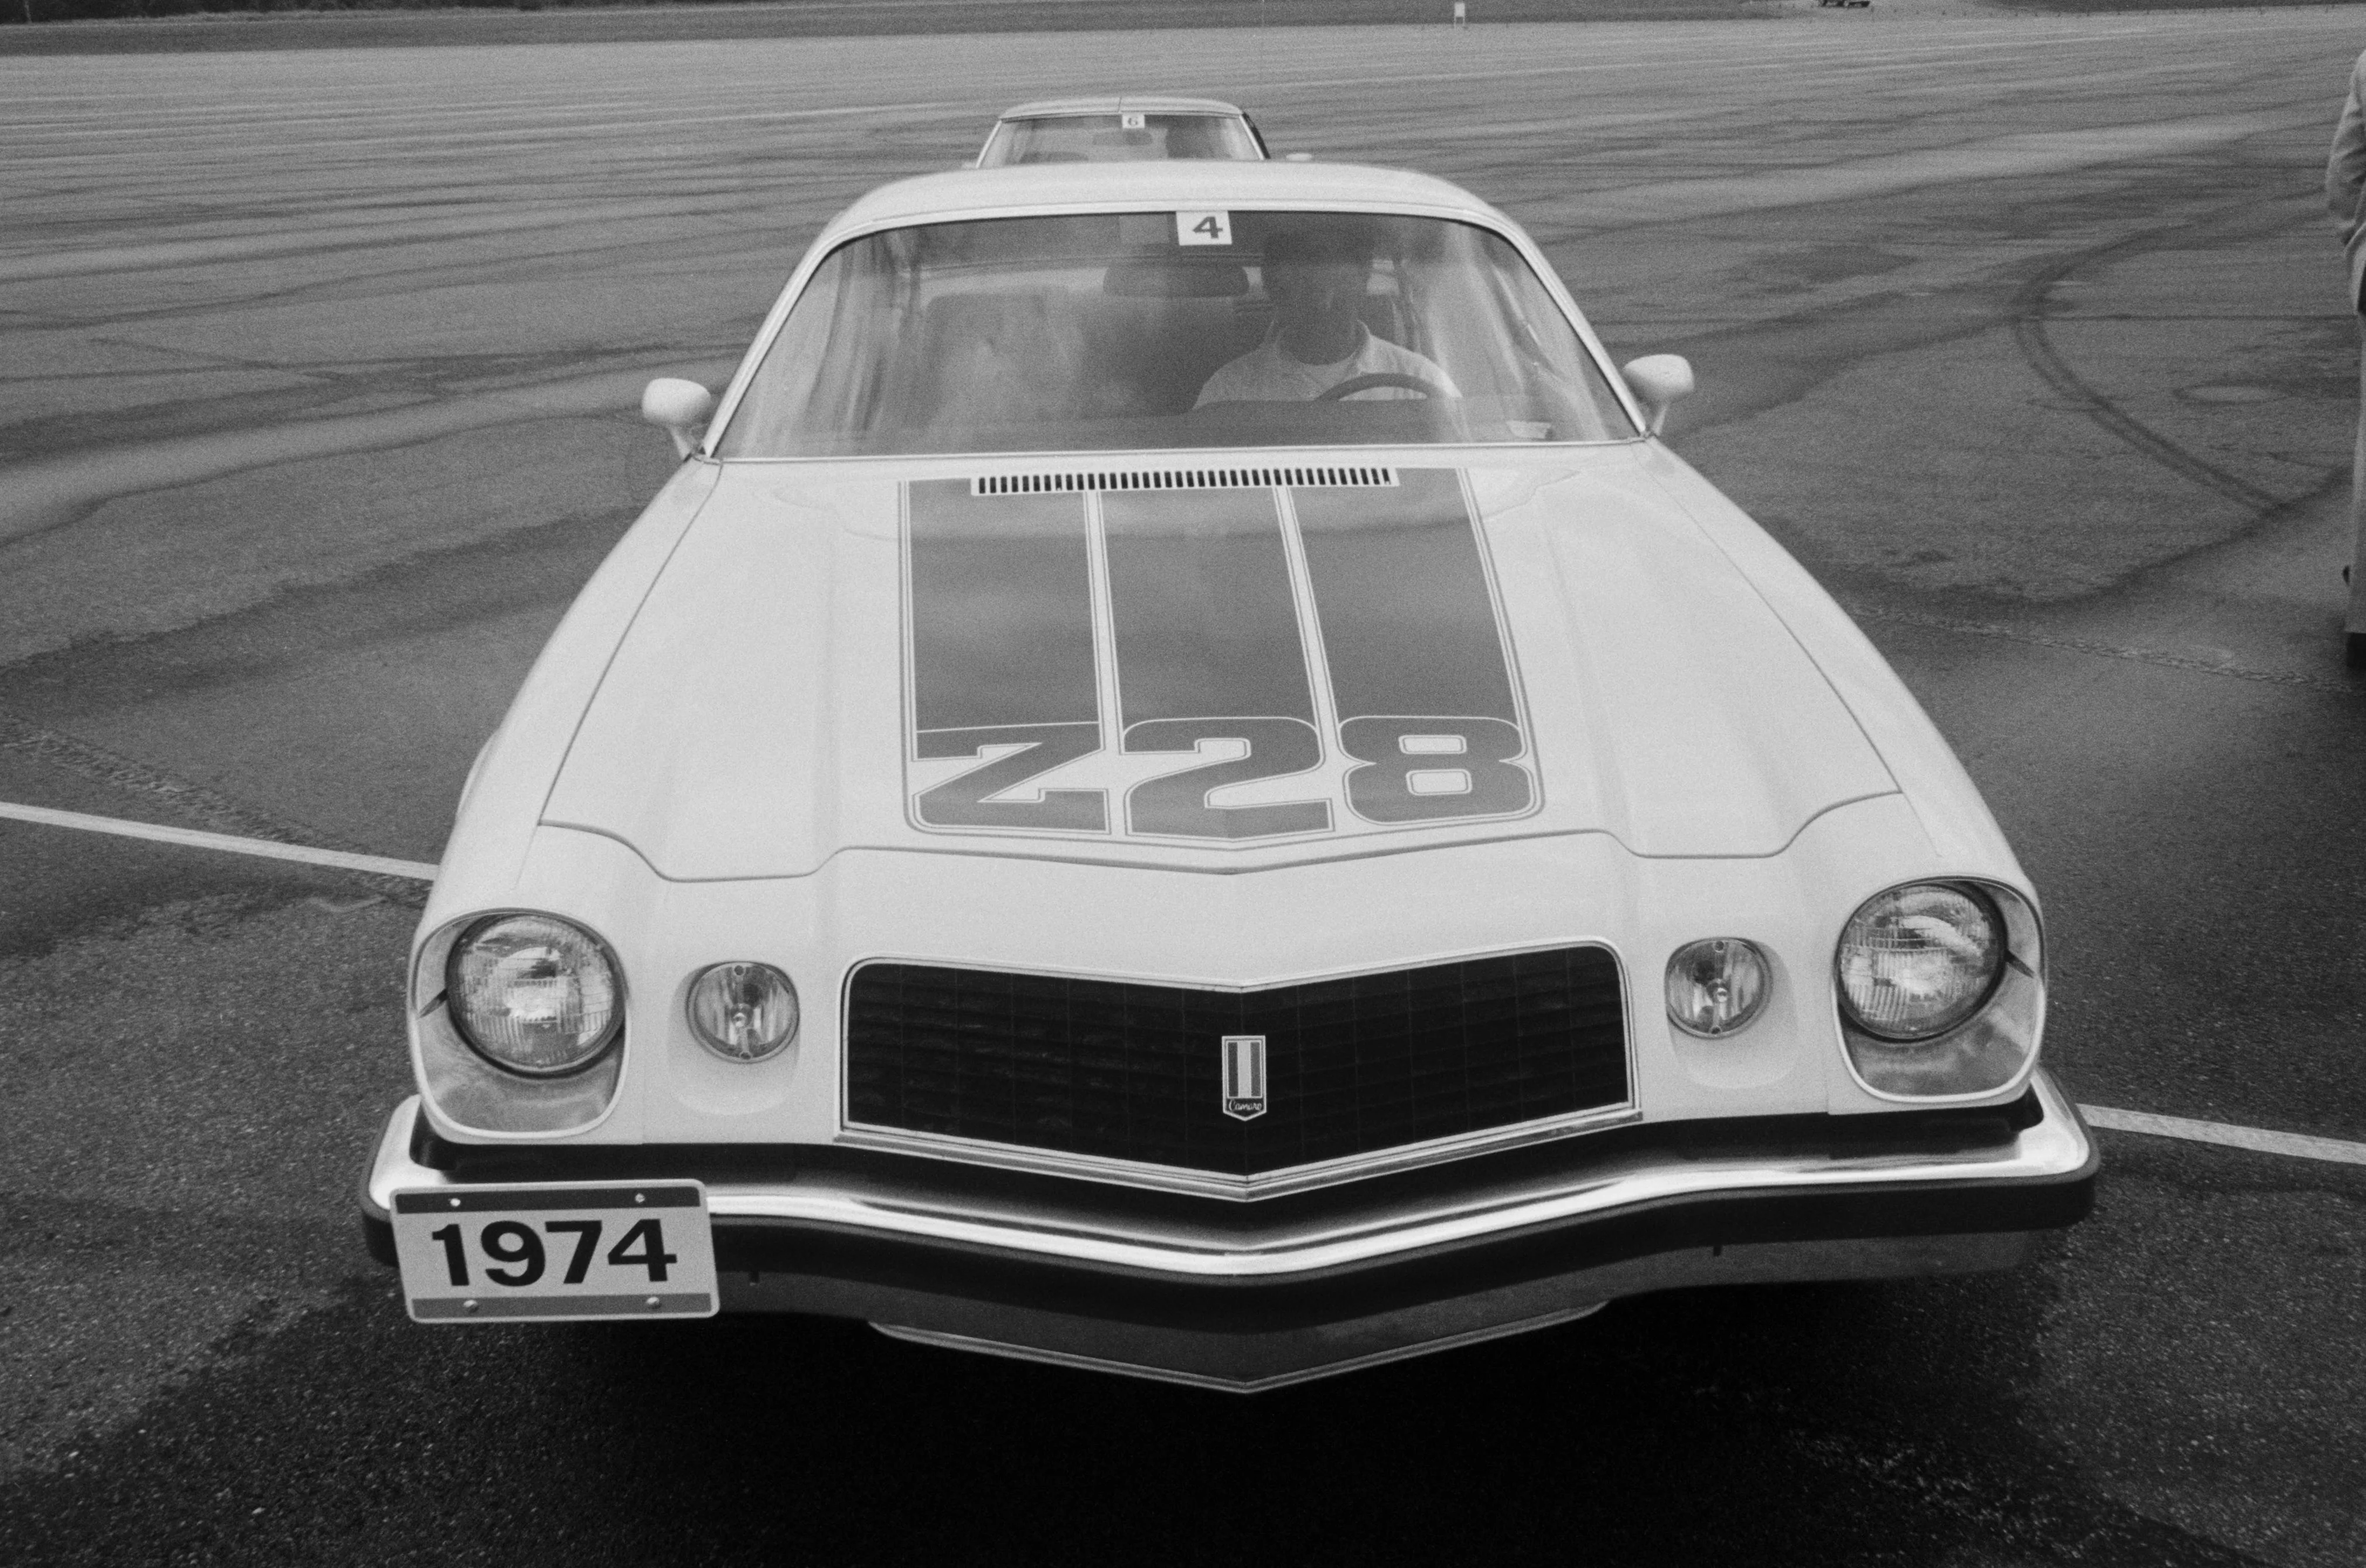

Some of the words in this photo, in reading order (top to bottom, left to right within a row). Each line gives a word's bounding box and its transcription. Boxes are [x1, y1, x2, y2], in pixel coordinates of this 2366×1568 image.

[1127, 117, 1138, 127] 6
[1193, 216, 1223, 239] 4
[911, 716, 1535, 839] Z28
[1228, 1098, 1262, 1111] Camaro
[432, 1218, 678, 1287] 1974
